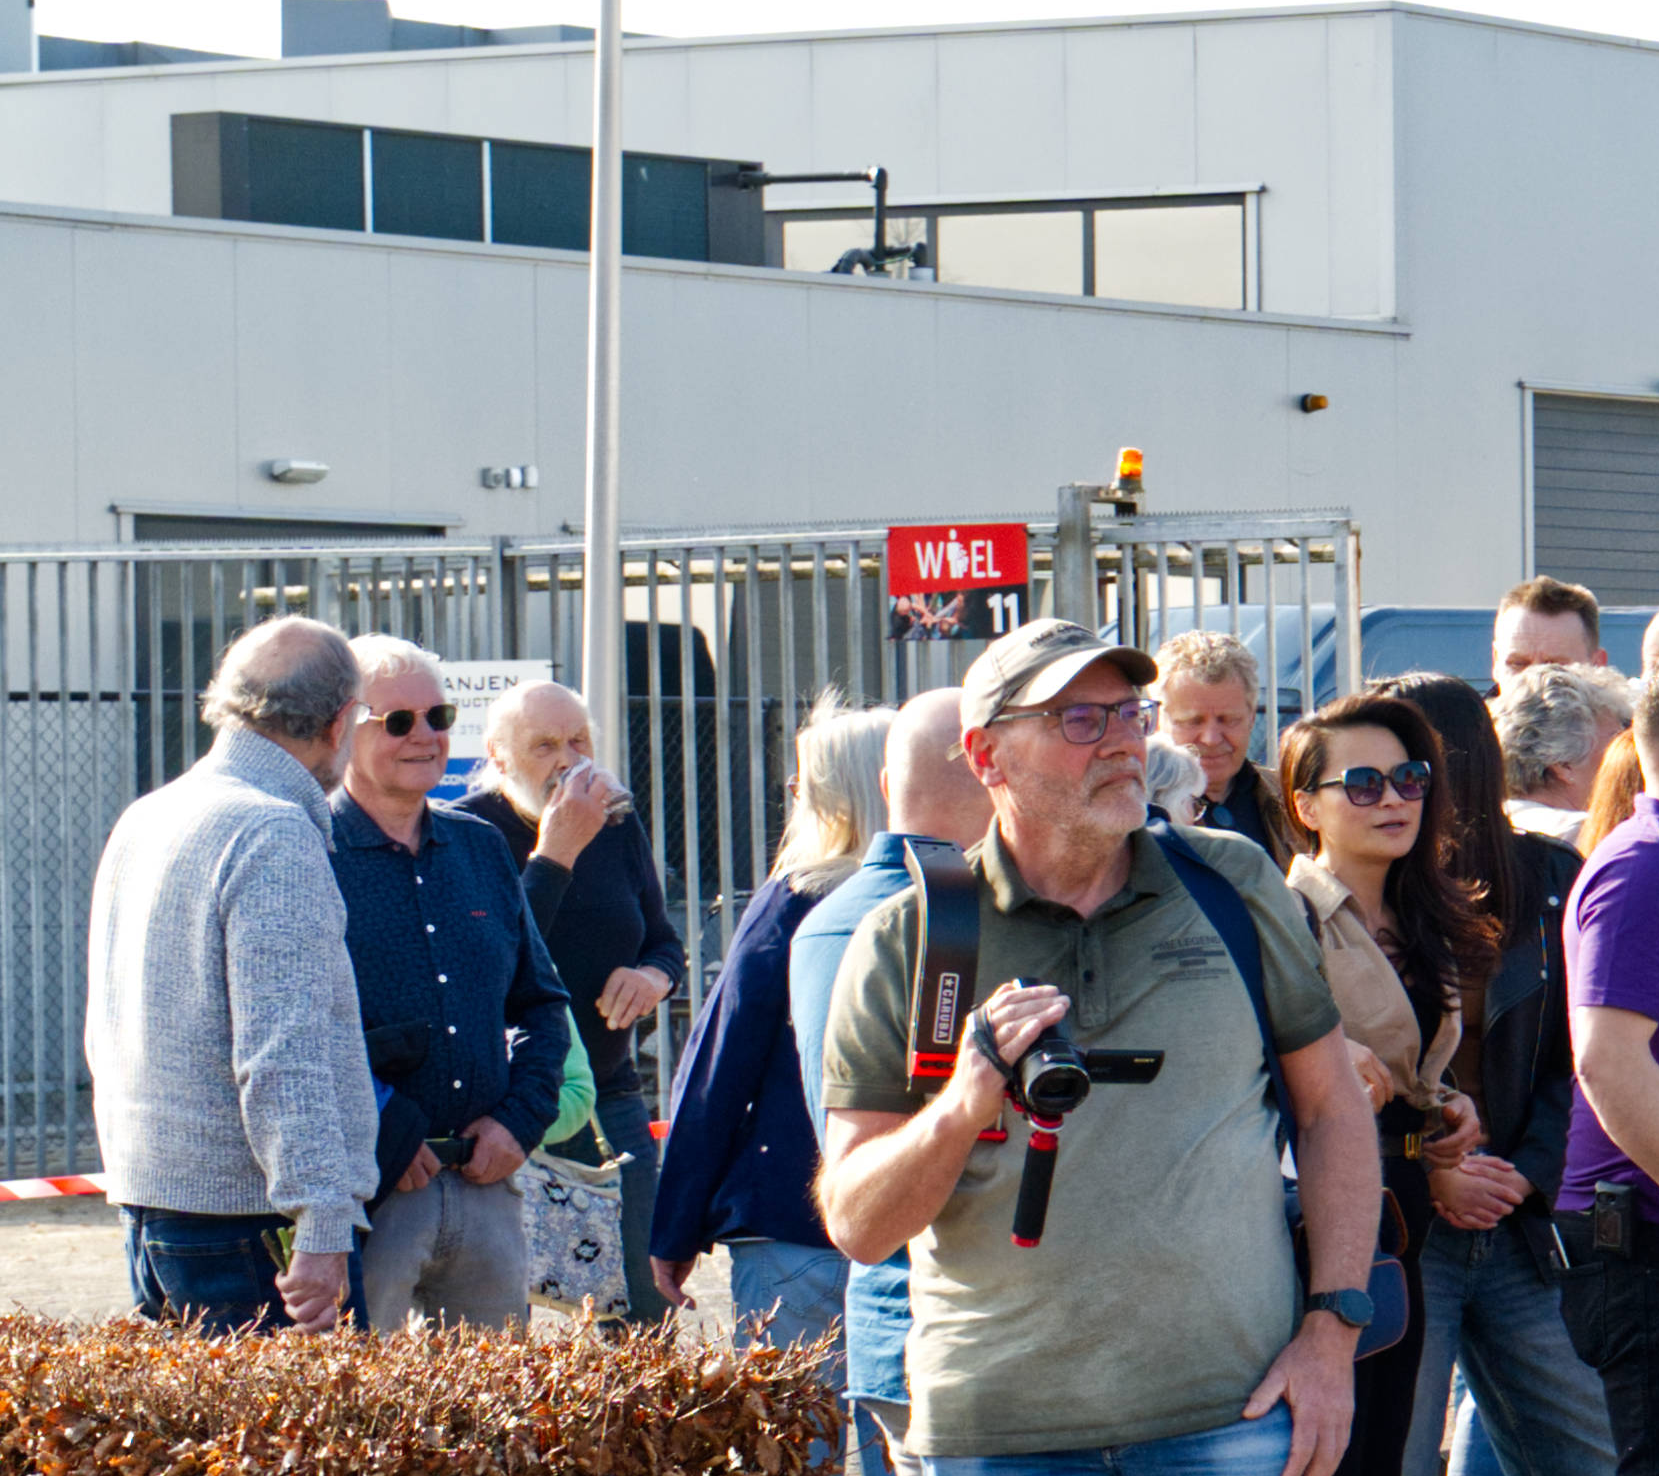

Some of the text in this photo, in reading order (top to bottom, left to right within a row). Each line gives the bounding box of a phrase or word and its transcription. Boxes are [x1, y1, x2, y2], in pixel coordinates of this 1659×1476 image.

[986, 592, 1020, 634] 11
[444, 675, 519, 691] ANJEN
[937, 989, 955, 1039] CARUBA
